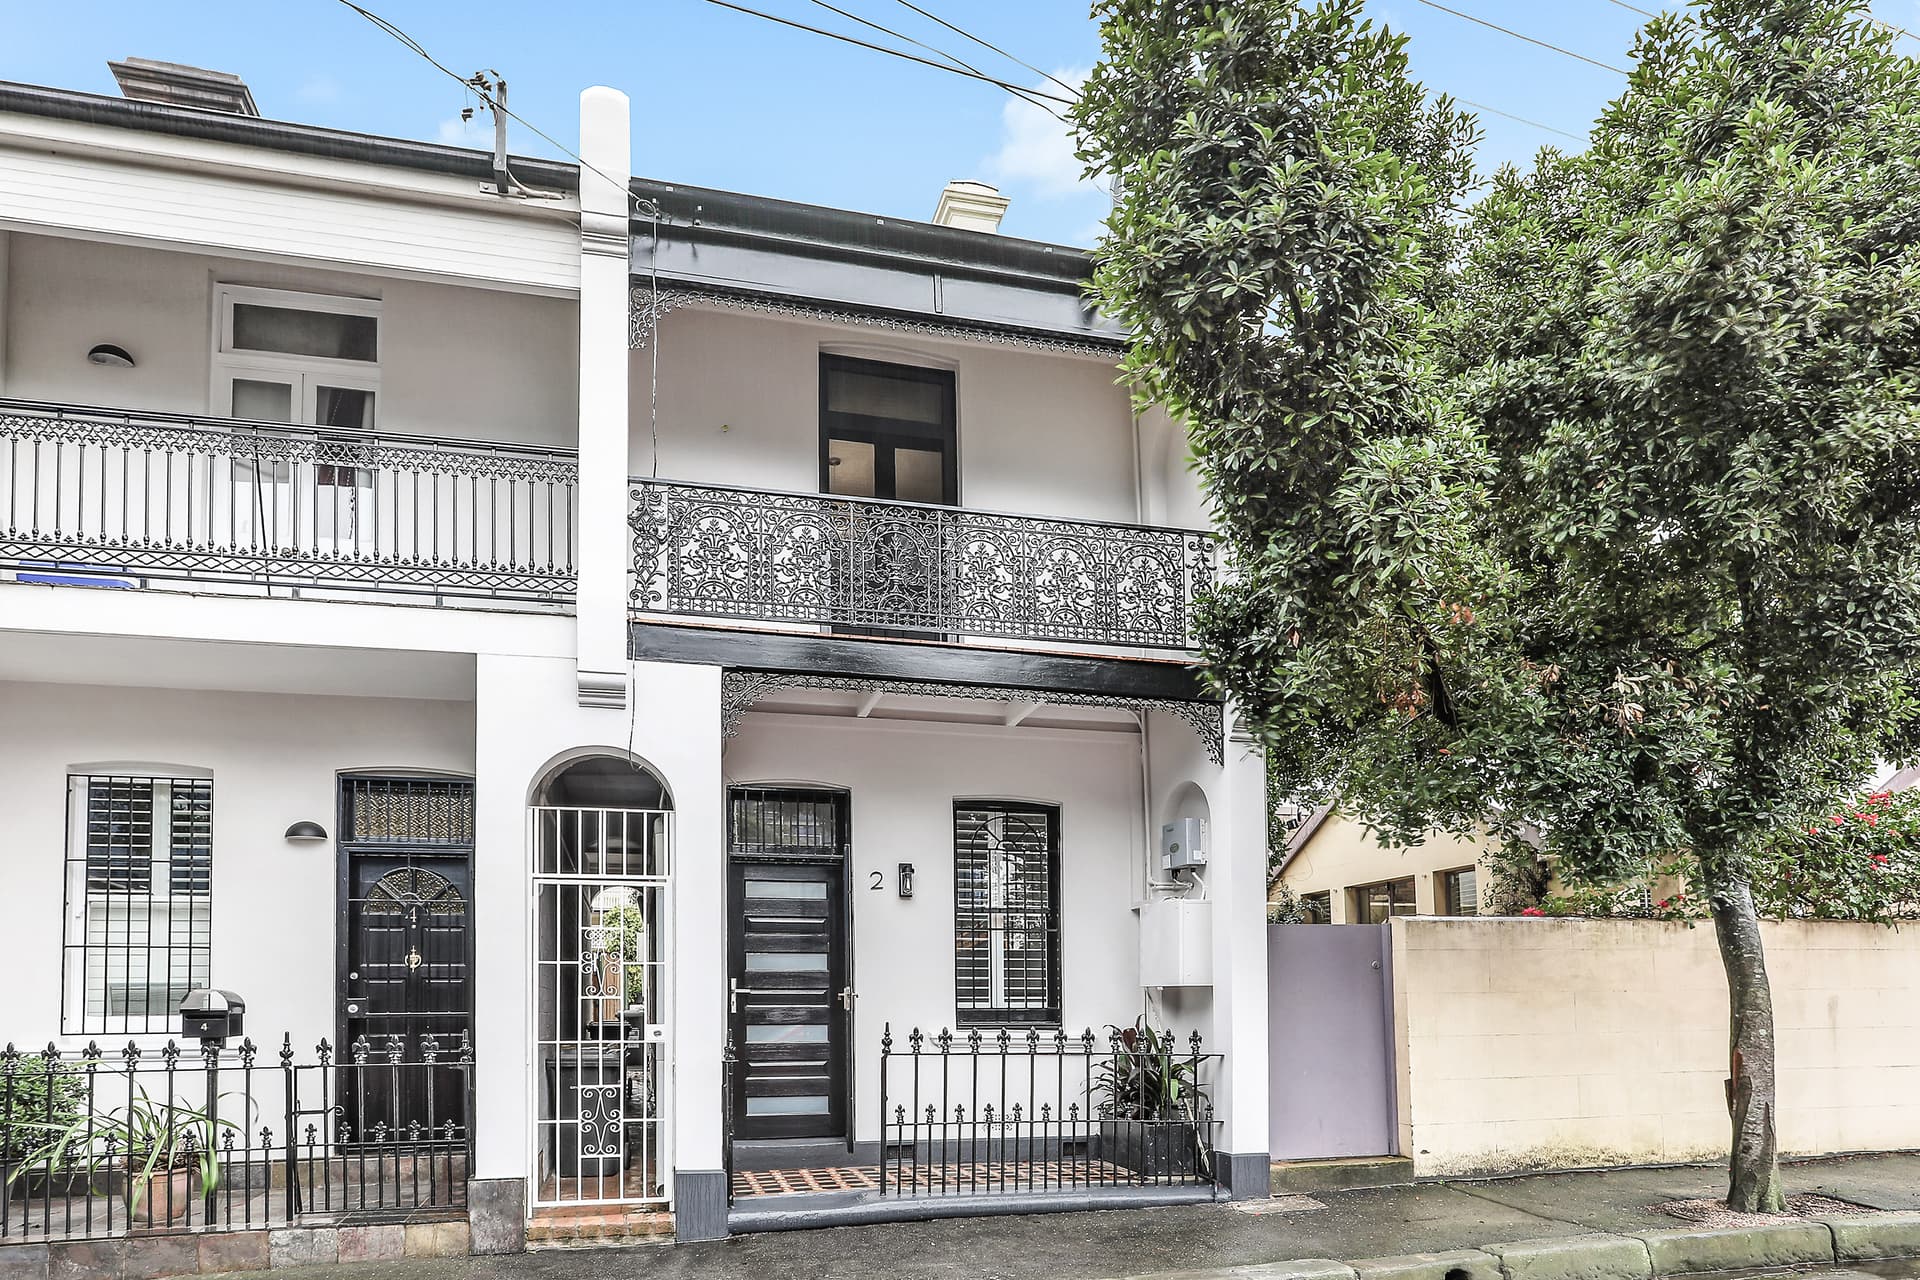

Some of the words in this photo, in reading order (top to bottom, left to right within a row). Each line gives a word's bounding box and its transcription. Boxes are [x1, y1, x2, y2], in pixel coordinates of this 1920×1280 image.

[869, 871, 884, 890] 2
[405, 906, 417, 923] 4
[200, 1022, 208, 1031] 4
